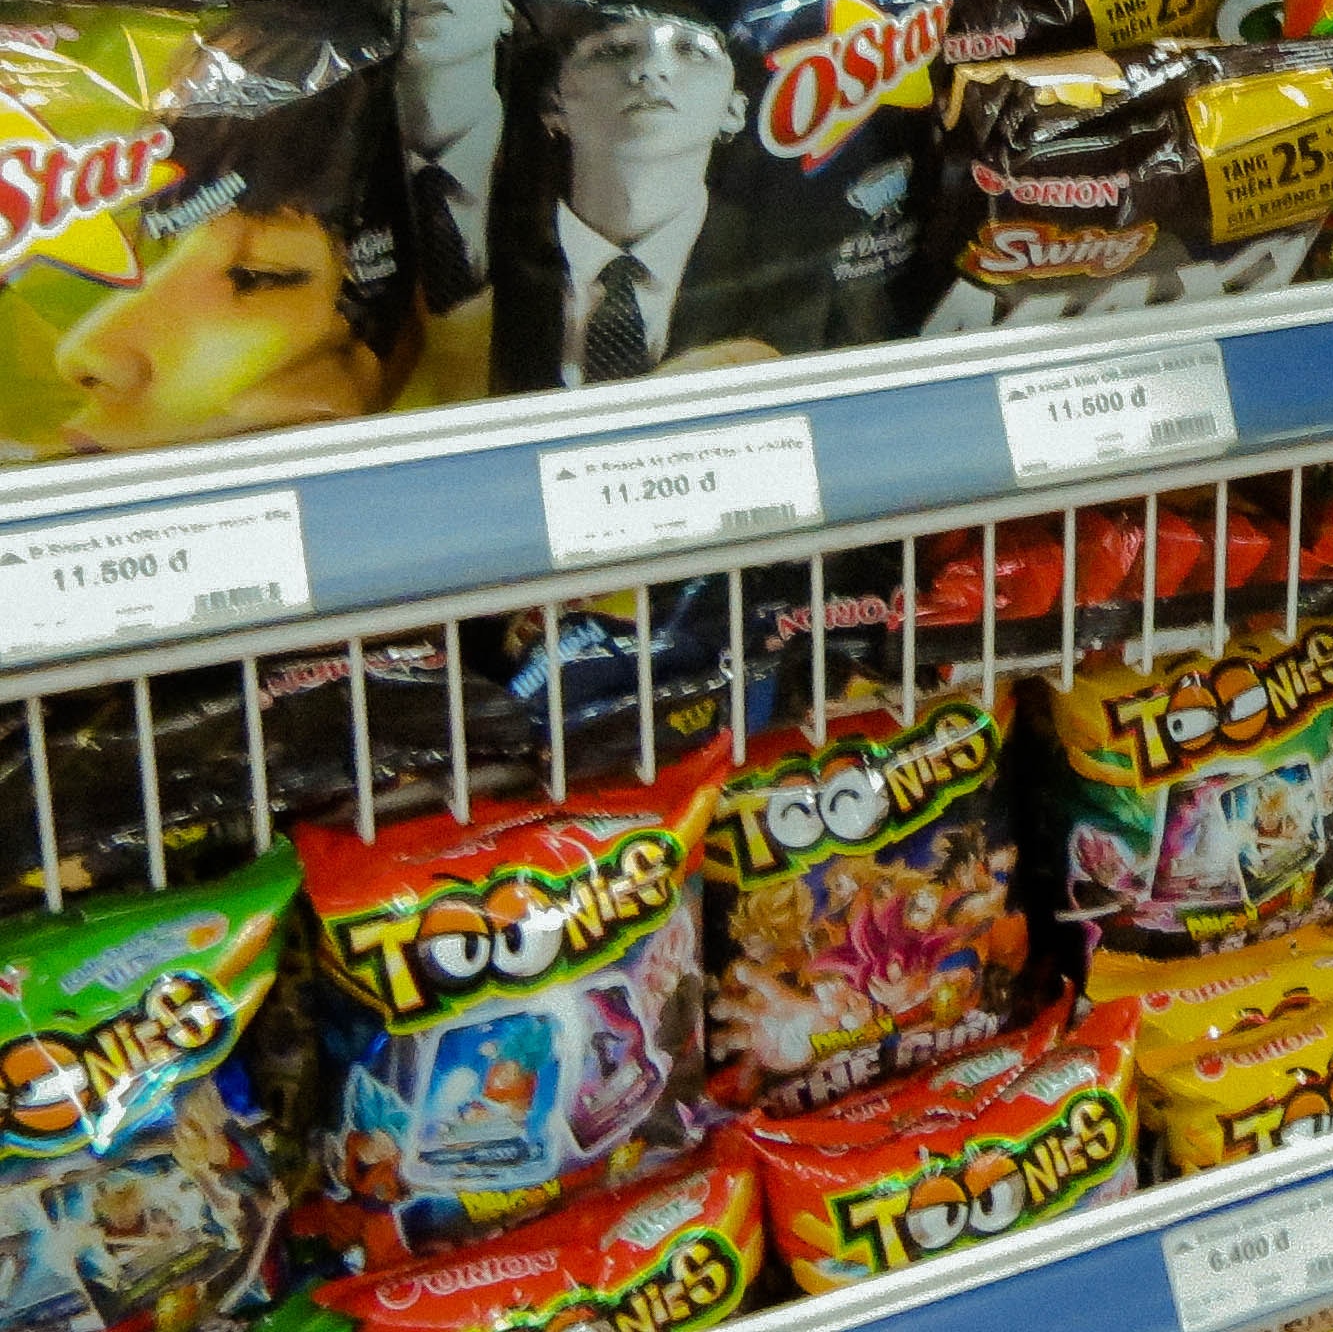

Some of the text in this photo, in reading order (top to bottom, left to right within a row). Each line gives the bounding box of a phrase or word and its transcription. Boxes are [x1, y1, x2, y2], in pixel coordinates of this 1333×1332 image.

[0, 128, 168, 250] Star
[1014, 173, 1124, 207] ORION
[1271, 133, 1326, 188] 25
[979, 229, 1147, 273] Swing
[718, 712, 987, 869] TOONIES
[347, 839, 671, 1012] TOONIES
[0, 971, 222, 1131] ONIES
[848, 1101, 1118, 1270] TOONIES
